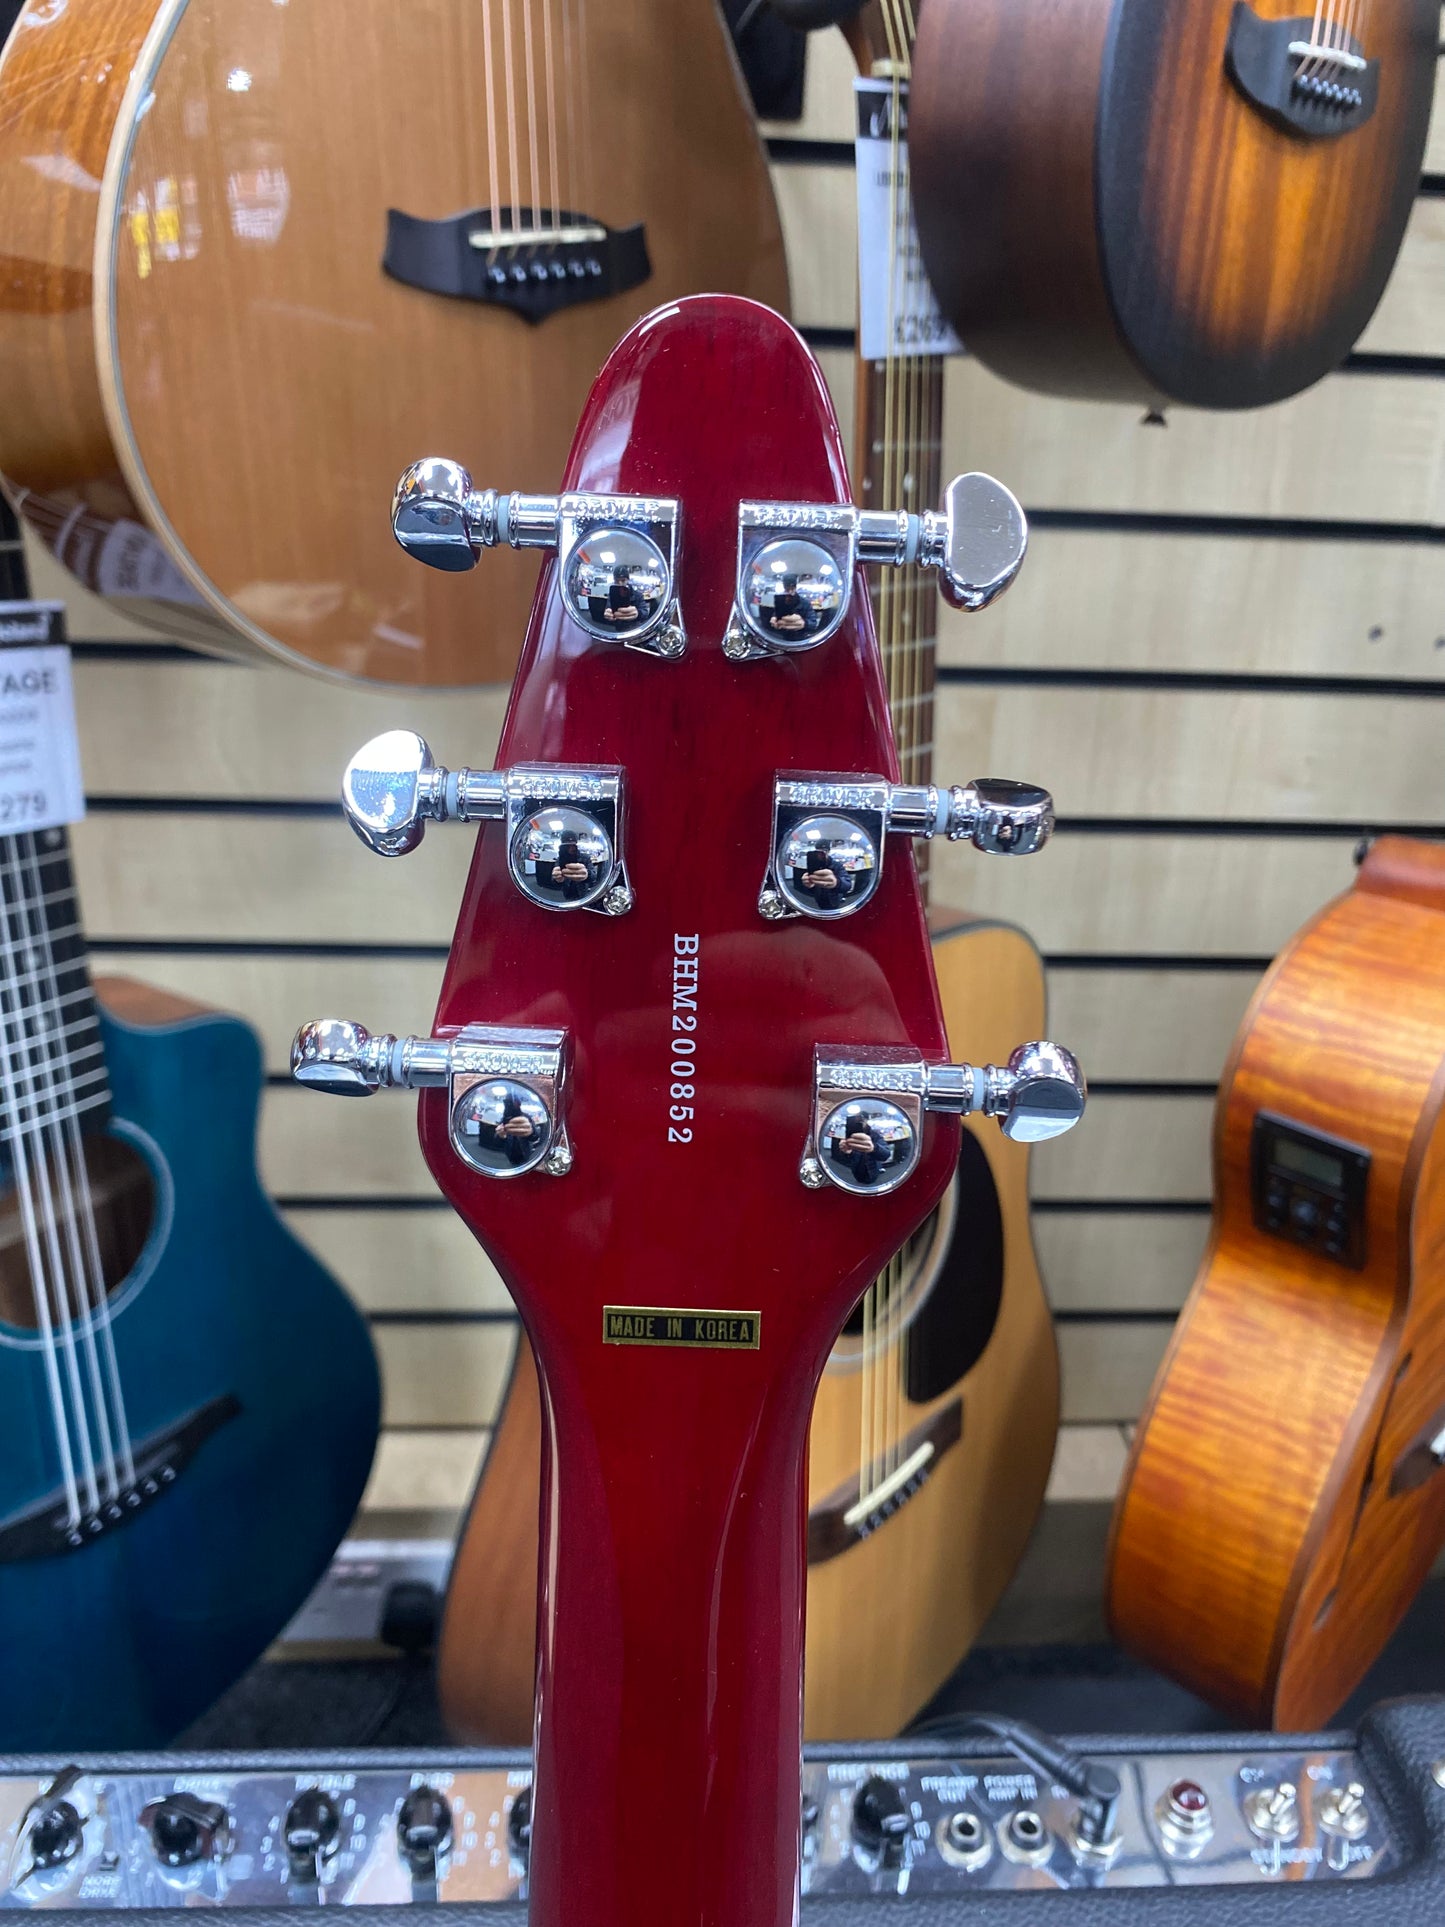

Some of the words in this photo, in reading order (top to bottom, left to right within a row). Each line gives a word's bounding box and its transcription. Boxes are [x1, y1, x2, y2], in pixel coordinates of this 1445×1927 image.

[0, 669, 57, 695] AGE
[667, 933, 700, 1144] BHM200852
[610, 1315, 655, 1337] MADE
[667, 1318, 682, 1338] IN
[695, 1319, 750, 1341] KOREA
